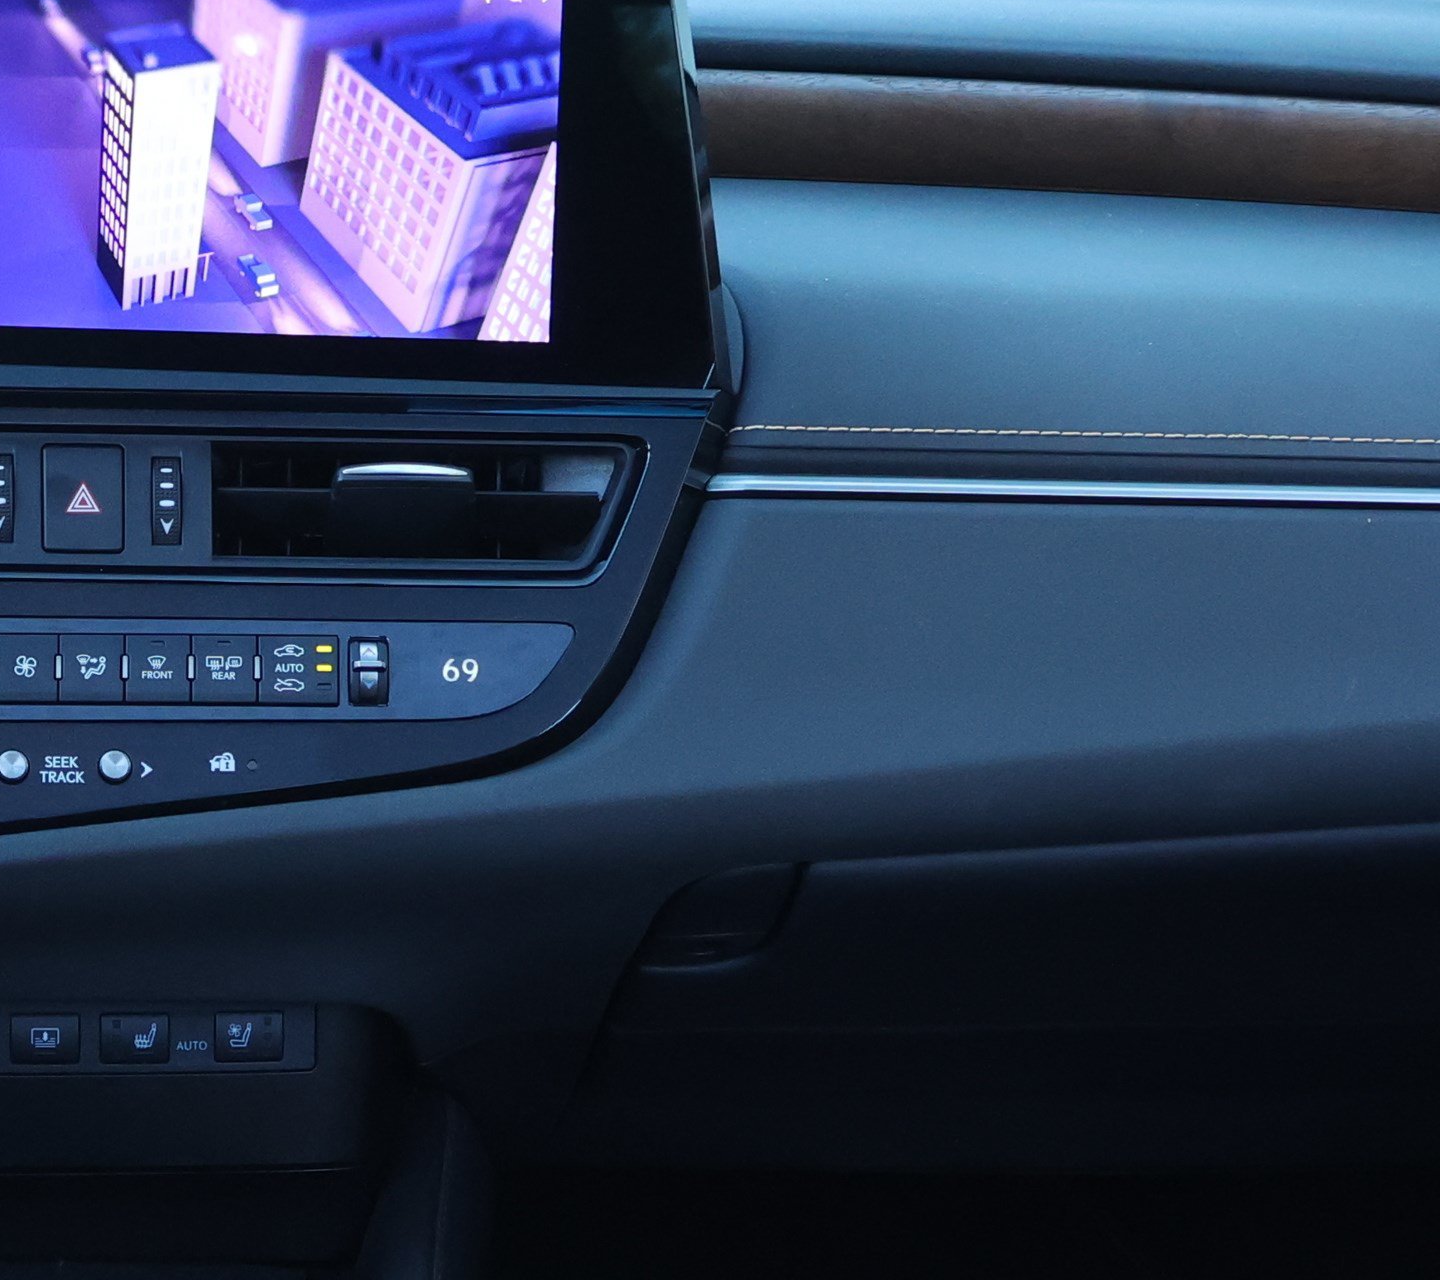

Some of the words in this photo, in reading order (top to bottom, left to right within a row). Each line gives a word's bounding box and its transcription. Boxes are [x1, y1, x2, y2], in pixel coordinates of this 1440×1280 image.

[275, 662, 304, 674] AUTO
[442, 657, 479, 683] 69
[141, 669, 173, 681] FRONT
[211, 670, 236, 682] REAR
[44, 755, 78, 769] SEEK
[39, 769, 85, 784] TRACK
[176, 1039, 208, 1052] AUTO
